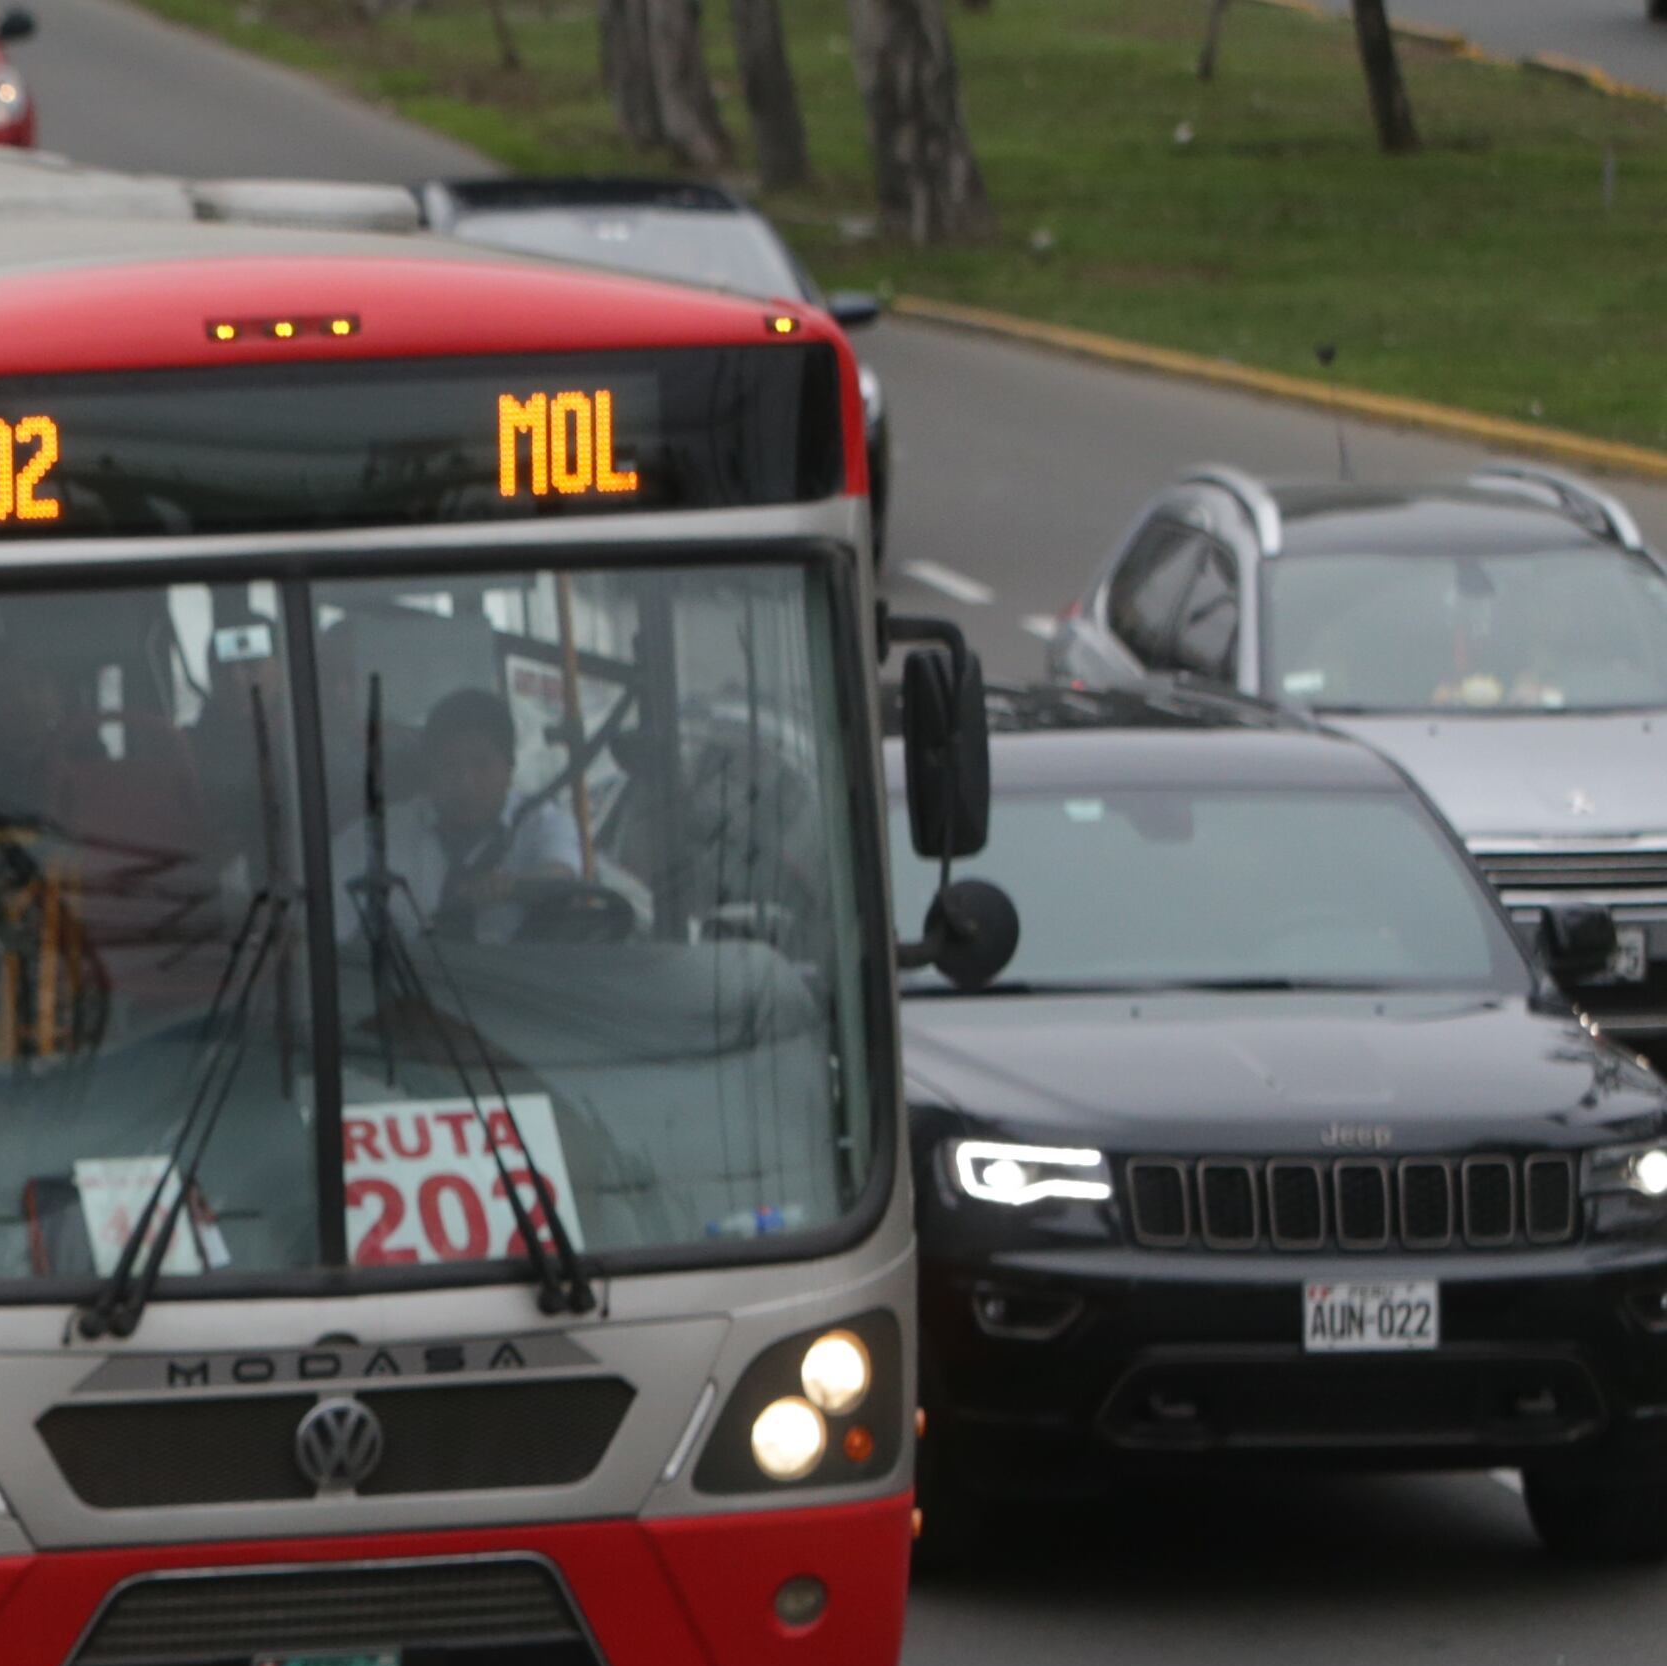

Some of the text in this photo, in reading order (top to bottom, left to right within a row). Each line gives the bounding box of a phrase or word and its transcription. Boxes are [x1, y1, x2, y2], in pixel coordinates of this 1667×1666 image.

[499, 390, 639, 498] MOL
[342, 1108, 526, 1164] RUTA
[1321, 1121, 1393, 1149] Jeep
[345, 1167, 559, 1267] 202
[1311, 1302, 1432, 1341] AUN-022
[169, 1340, 527, 1387] MODASA
